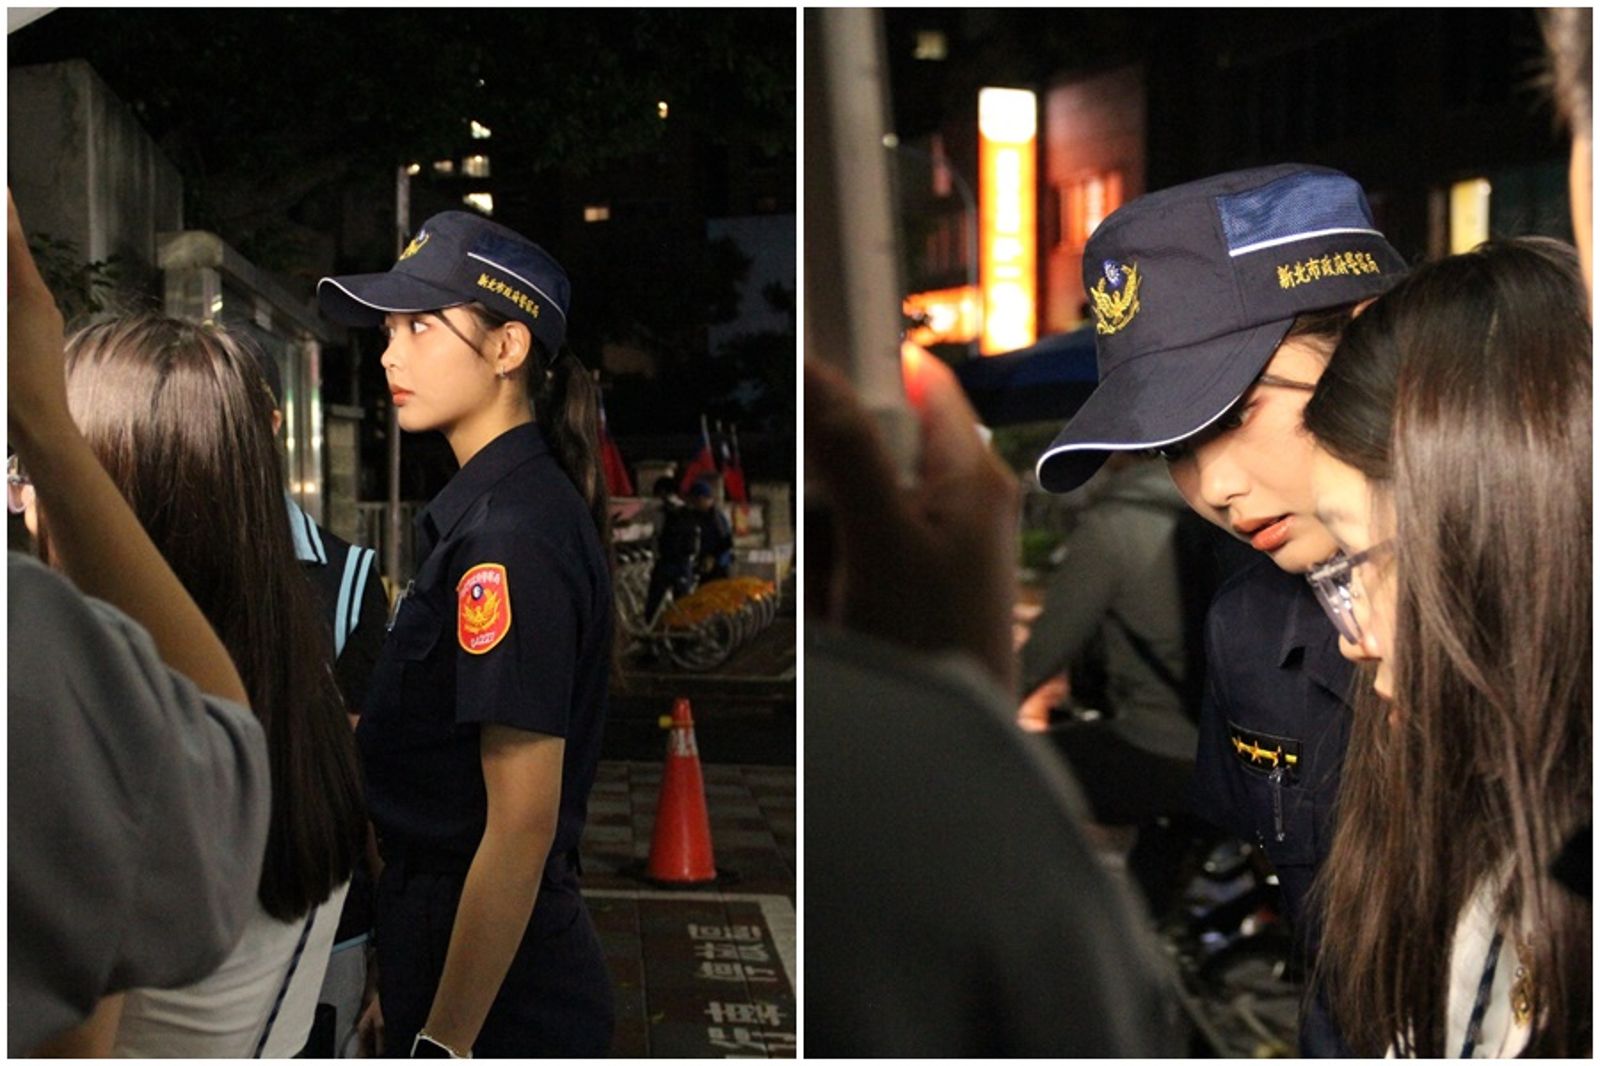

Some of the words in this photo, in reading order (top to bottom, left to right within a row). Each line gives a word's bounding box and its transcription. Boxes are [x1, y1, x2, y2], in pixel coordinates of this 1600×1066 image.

[1276, 251, 1380, 289] 新北市政府警察局
